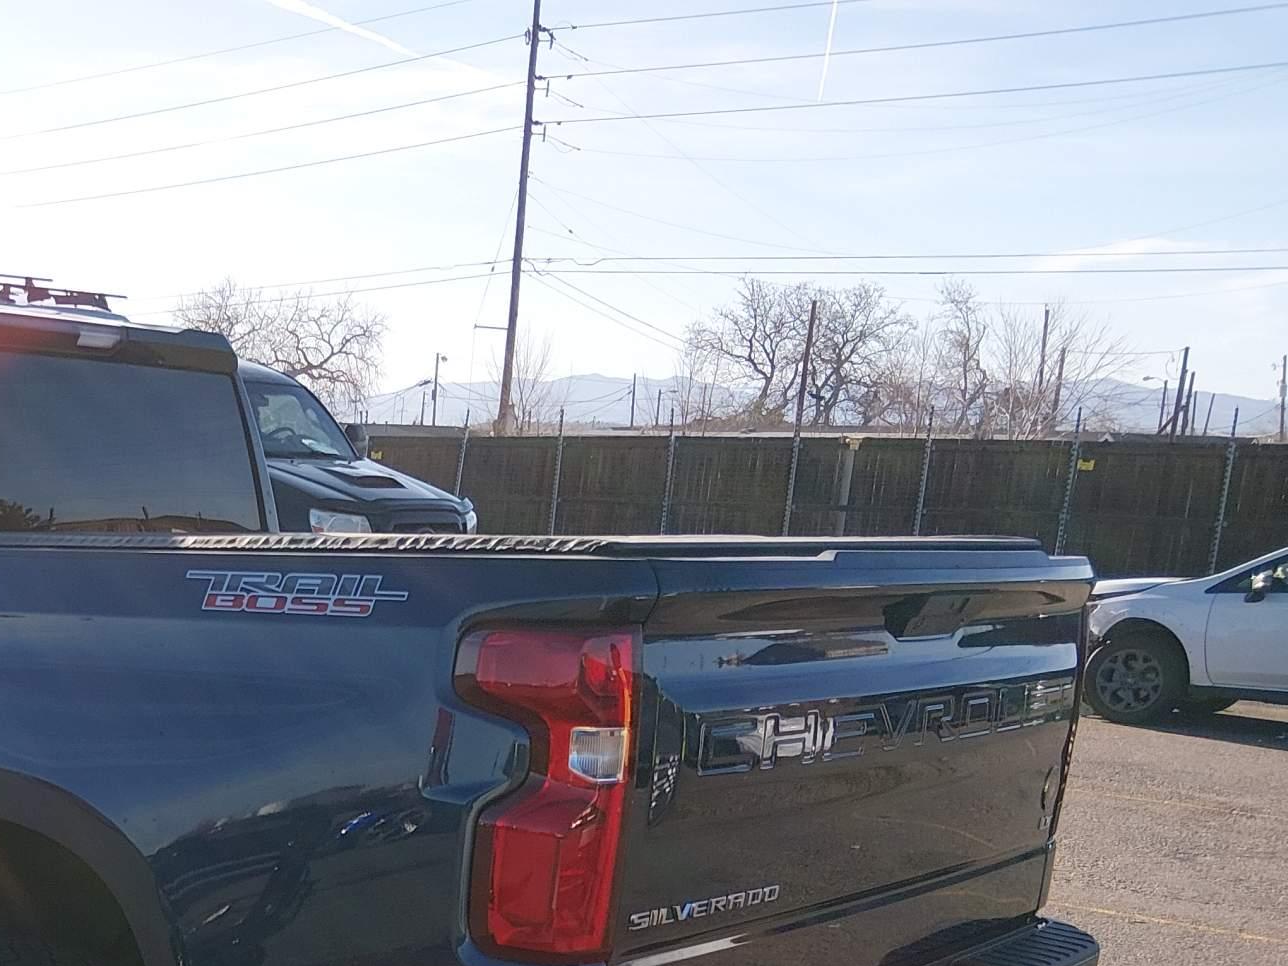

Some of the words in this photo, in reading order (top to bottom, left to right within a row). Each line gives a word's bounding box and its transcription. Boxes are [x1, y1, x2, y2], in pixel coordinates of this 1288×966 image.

[186, 569, 408, 601] TRAIL
[201, 592, 376, 617] BOSS
[627, 884, 780, 930] SILVERADO
